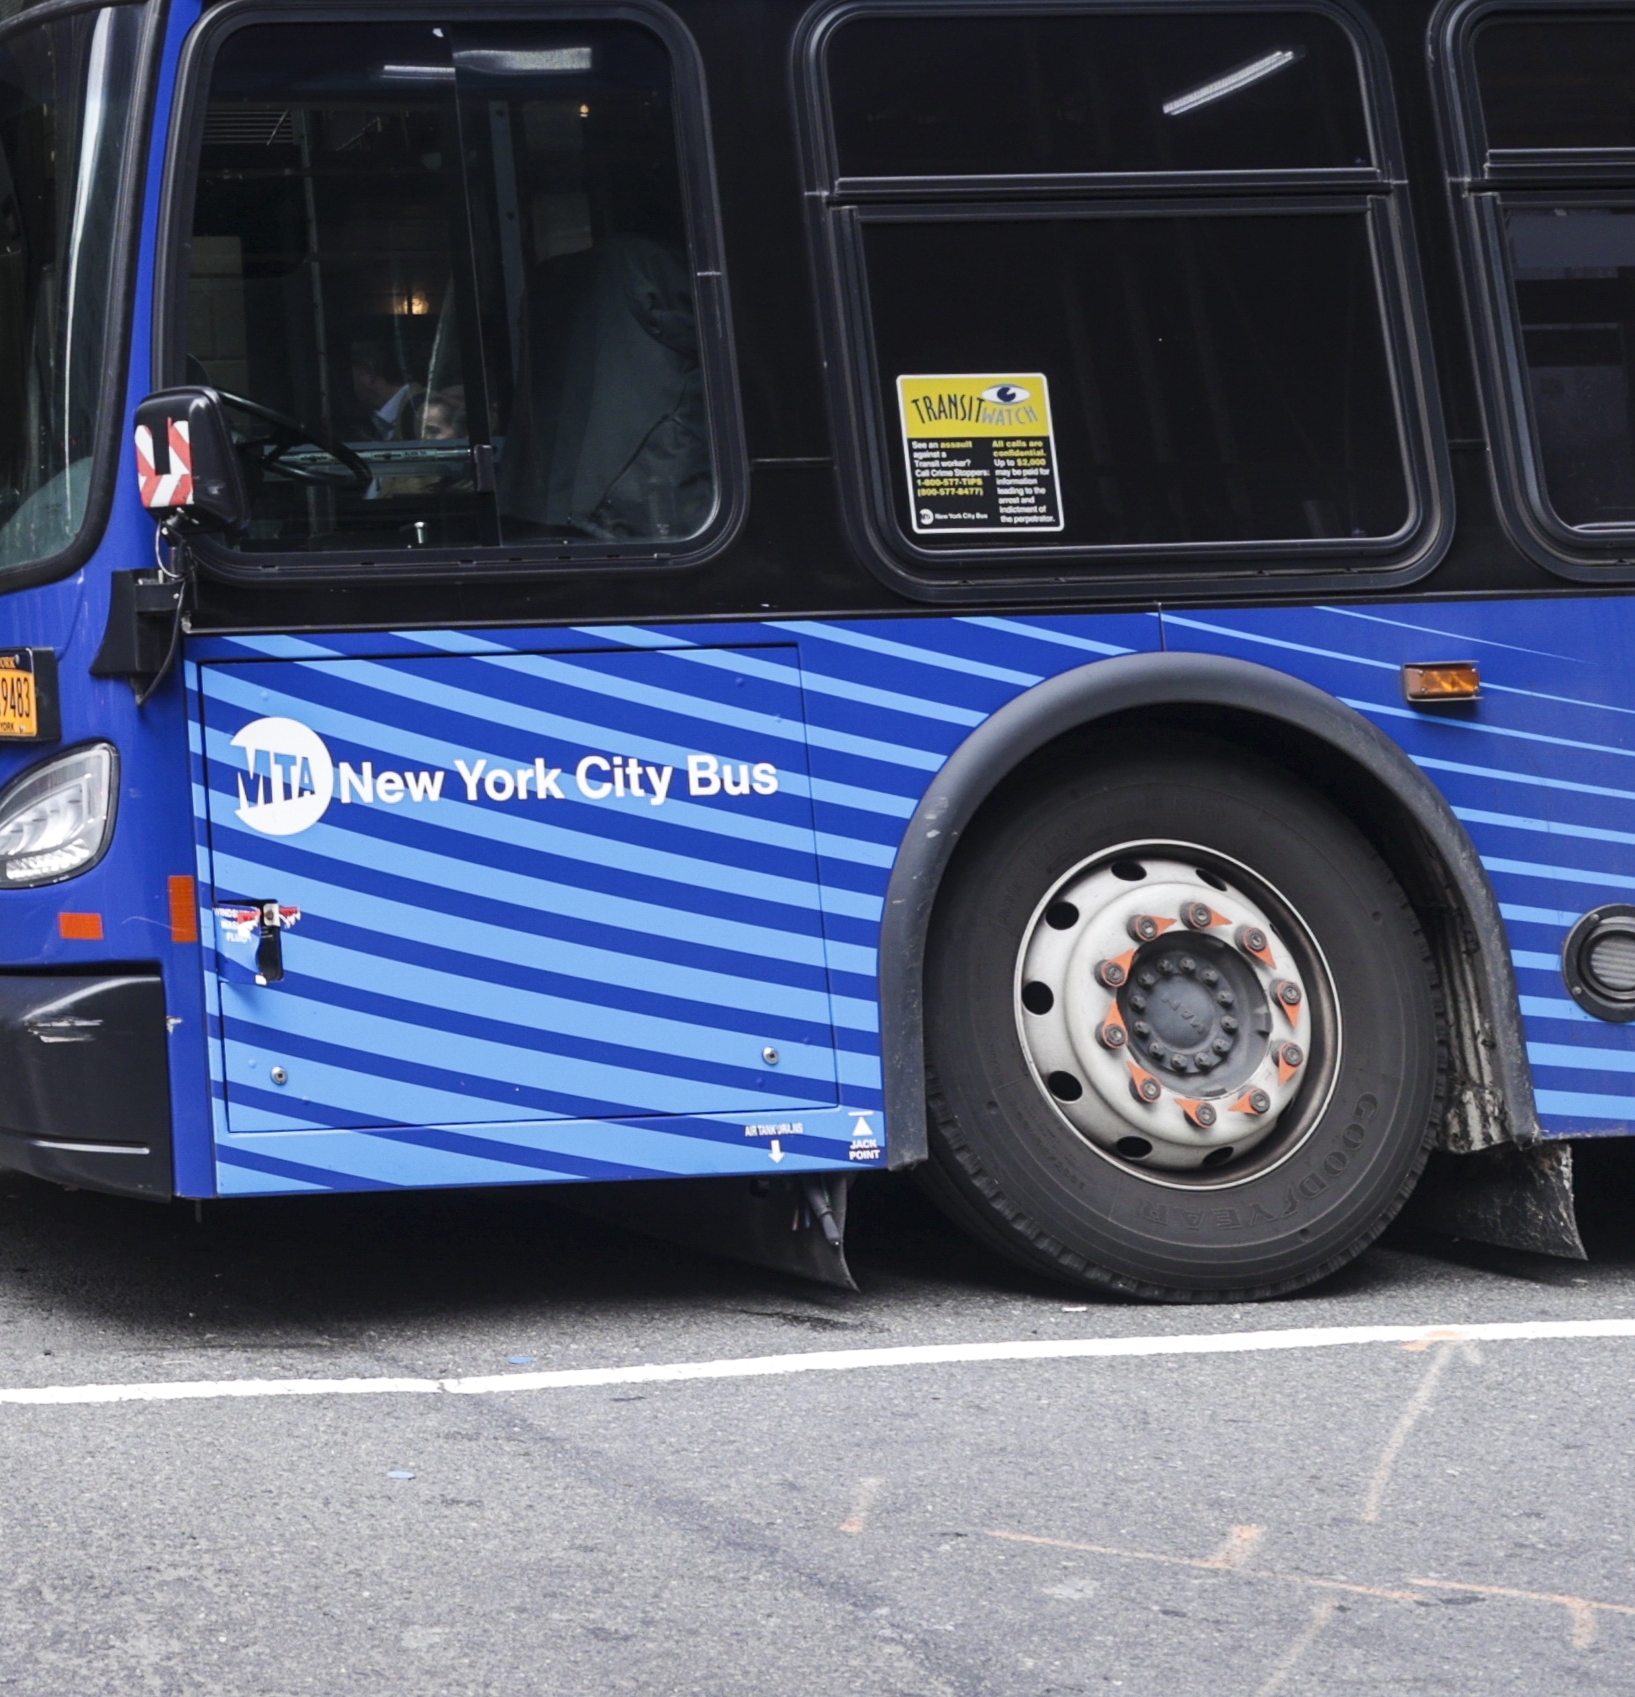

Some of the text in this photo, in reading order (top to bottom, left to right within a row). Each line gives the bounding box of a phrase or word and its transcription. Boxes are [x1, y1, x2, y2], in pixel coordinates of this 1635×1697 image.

[912, 441, 927, 449] See
[940, 440, 973, 449] assault
[992, 440, 1004, 448] All
[1006, 440, 1027, 448] calls
[913, 451, 947, 460] against a
[993, 449, 1047, 457] confidential.
[914, 459, 971, 468] Transit worker?
[994, 458, 1046, 468] Up to $2,000
[915, 469, 930, 477] Call
[931, 469, 953, 477] Crime
[995, 467, 1050, 477] may be paid for
[916, 478, 983, 487] 1-800-577-TIPS
[996, 477, 1038, 485] information
[917, 487, 984, 497] (800-577-8477)
[997, 487, 1046, 496] leading to the
[1021, 496, 1035, 504] and
[999, 505, 1047, 514] indictment of
[934, 512, 948, 520] New
[962, 512, 975, 520] City
[976, 512, 988, 520] Bus
[1000, 515, 1056, 524] the perpetrator.
[1, 677, 30, 718] 9483
[0, 722, 14, 731] YORK
[338, 761, 445, 804] New
[453, 757, 565, 802] York
[576, 755, 674, 806] City
[687, 754, 779, 797] Bus
[745, 1125, 757, 1137] AIR
[850, 1139, 878, 1149] JACK
[848, 1149, 881, 1160] POINT
